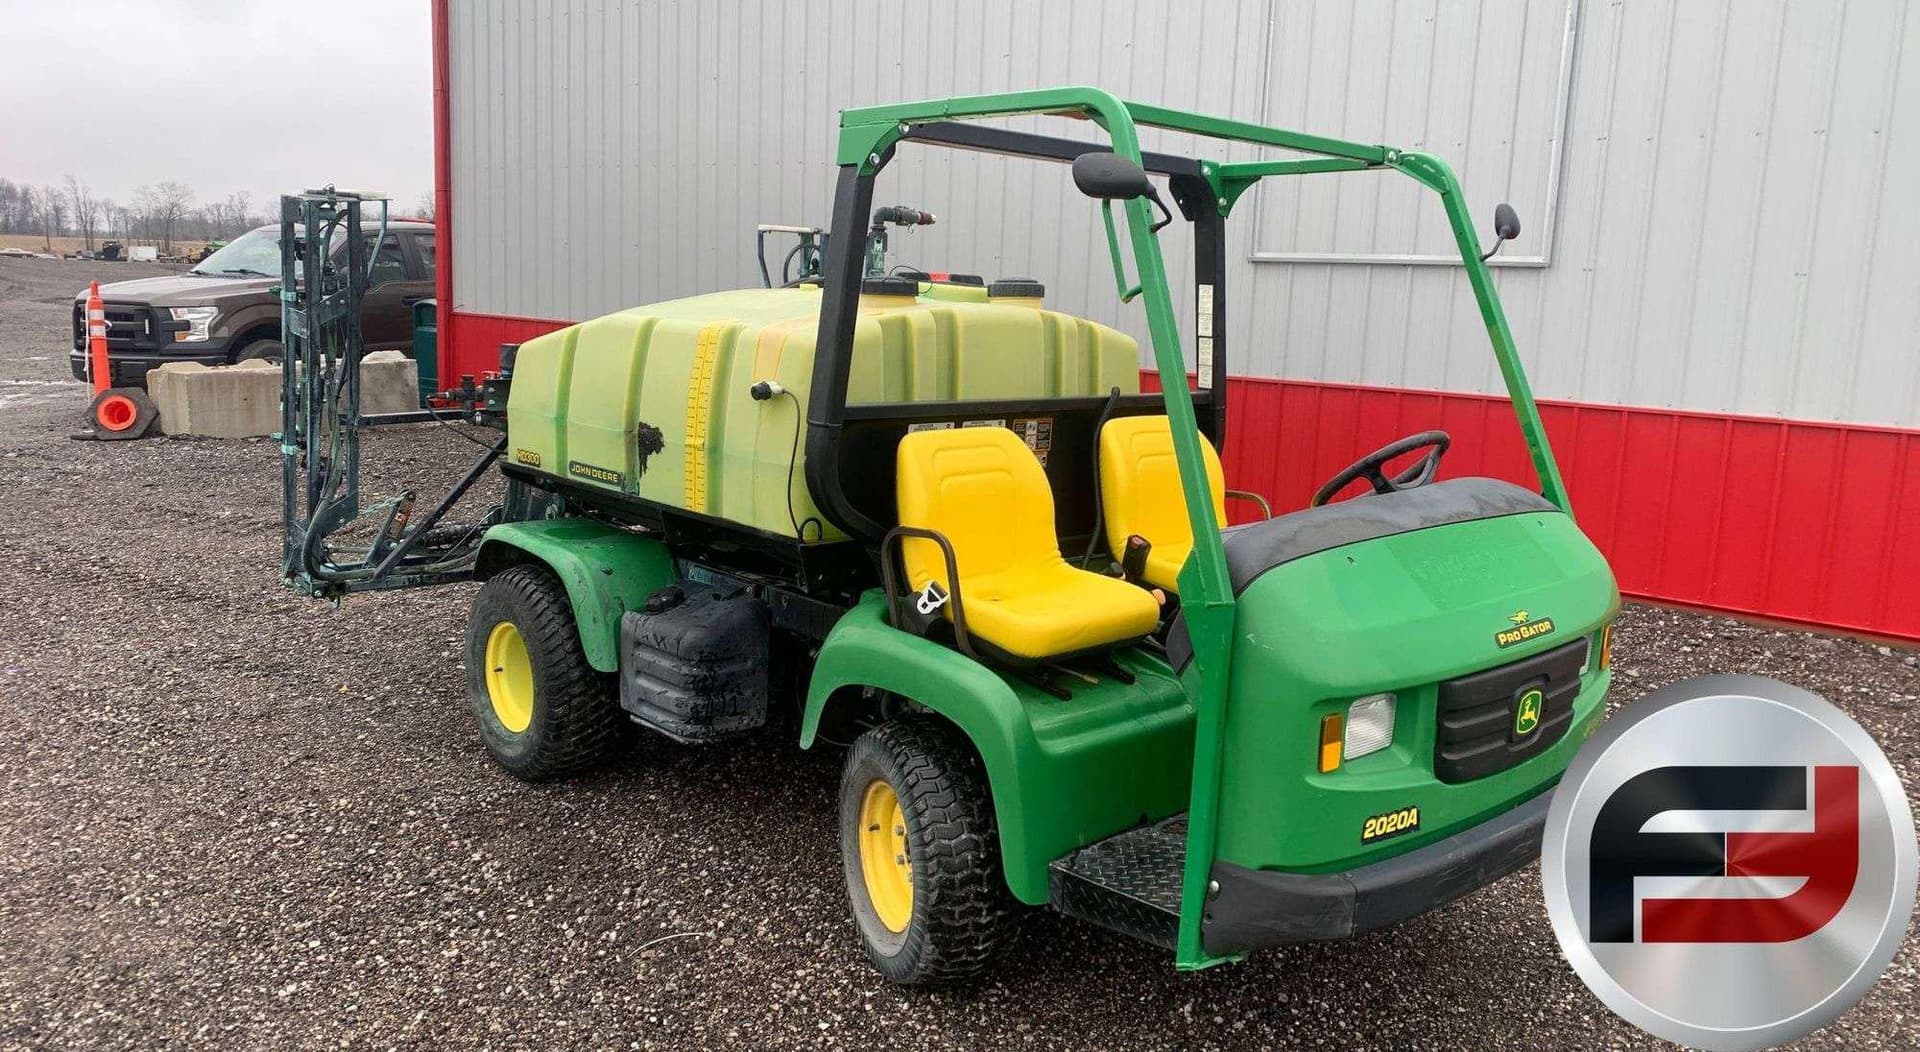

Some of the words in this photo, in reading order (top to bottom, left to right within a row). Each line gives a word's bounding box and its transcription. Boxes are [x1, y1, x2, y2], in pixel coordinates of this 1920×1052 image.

[570, 463, 592, 476] JOHN
[591, 469, 619, 482] DEERE
[1363, 807, 1418, 839] 2020A
